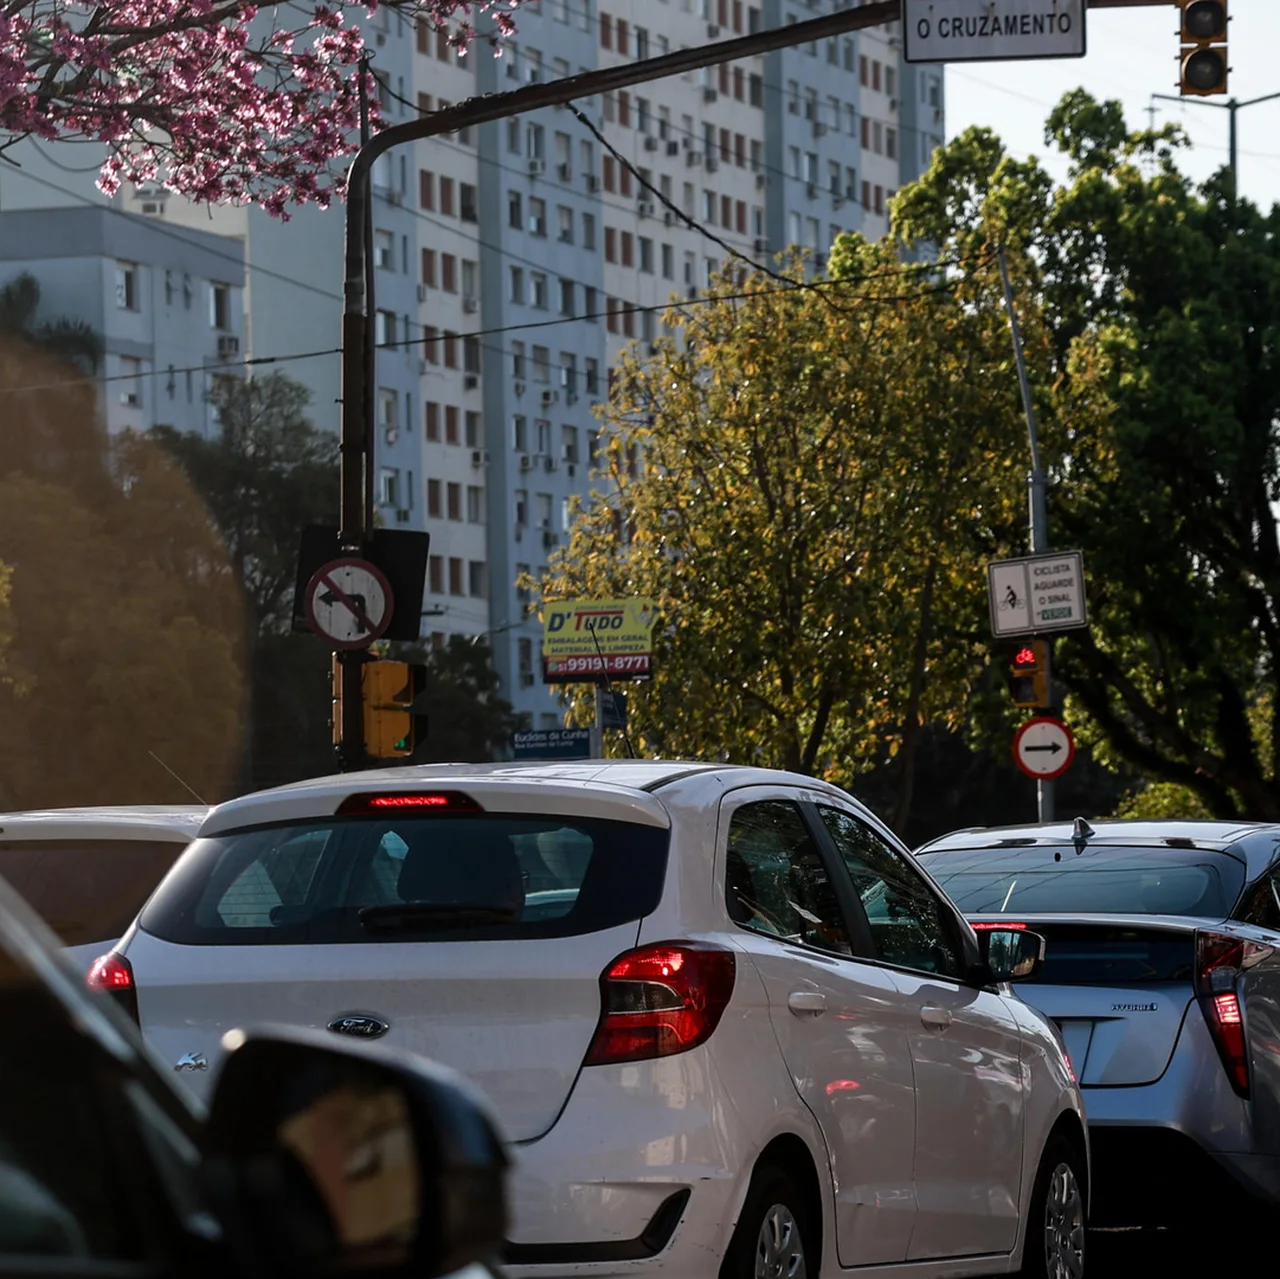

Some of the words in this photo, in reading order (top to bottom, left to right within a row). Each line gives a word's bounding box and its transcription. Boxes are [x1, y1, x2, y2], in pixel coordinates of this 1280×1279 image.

[917, 18, 931, 39] O
[938, 12, 1072, 38] CRUZAMENTO
[1033, 564, 1071, 576] CICLISTA
[1033, 578, 1075, 591] AGUARDE
[568, 656, 649, 671] 99191-8771
[561, 730, 589, 740] Cunha
[341, 1019, 374, 1033] Ford
